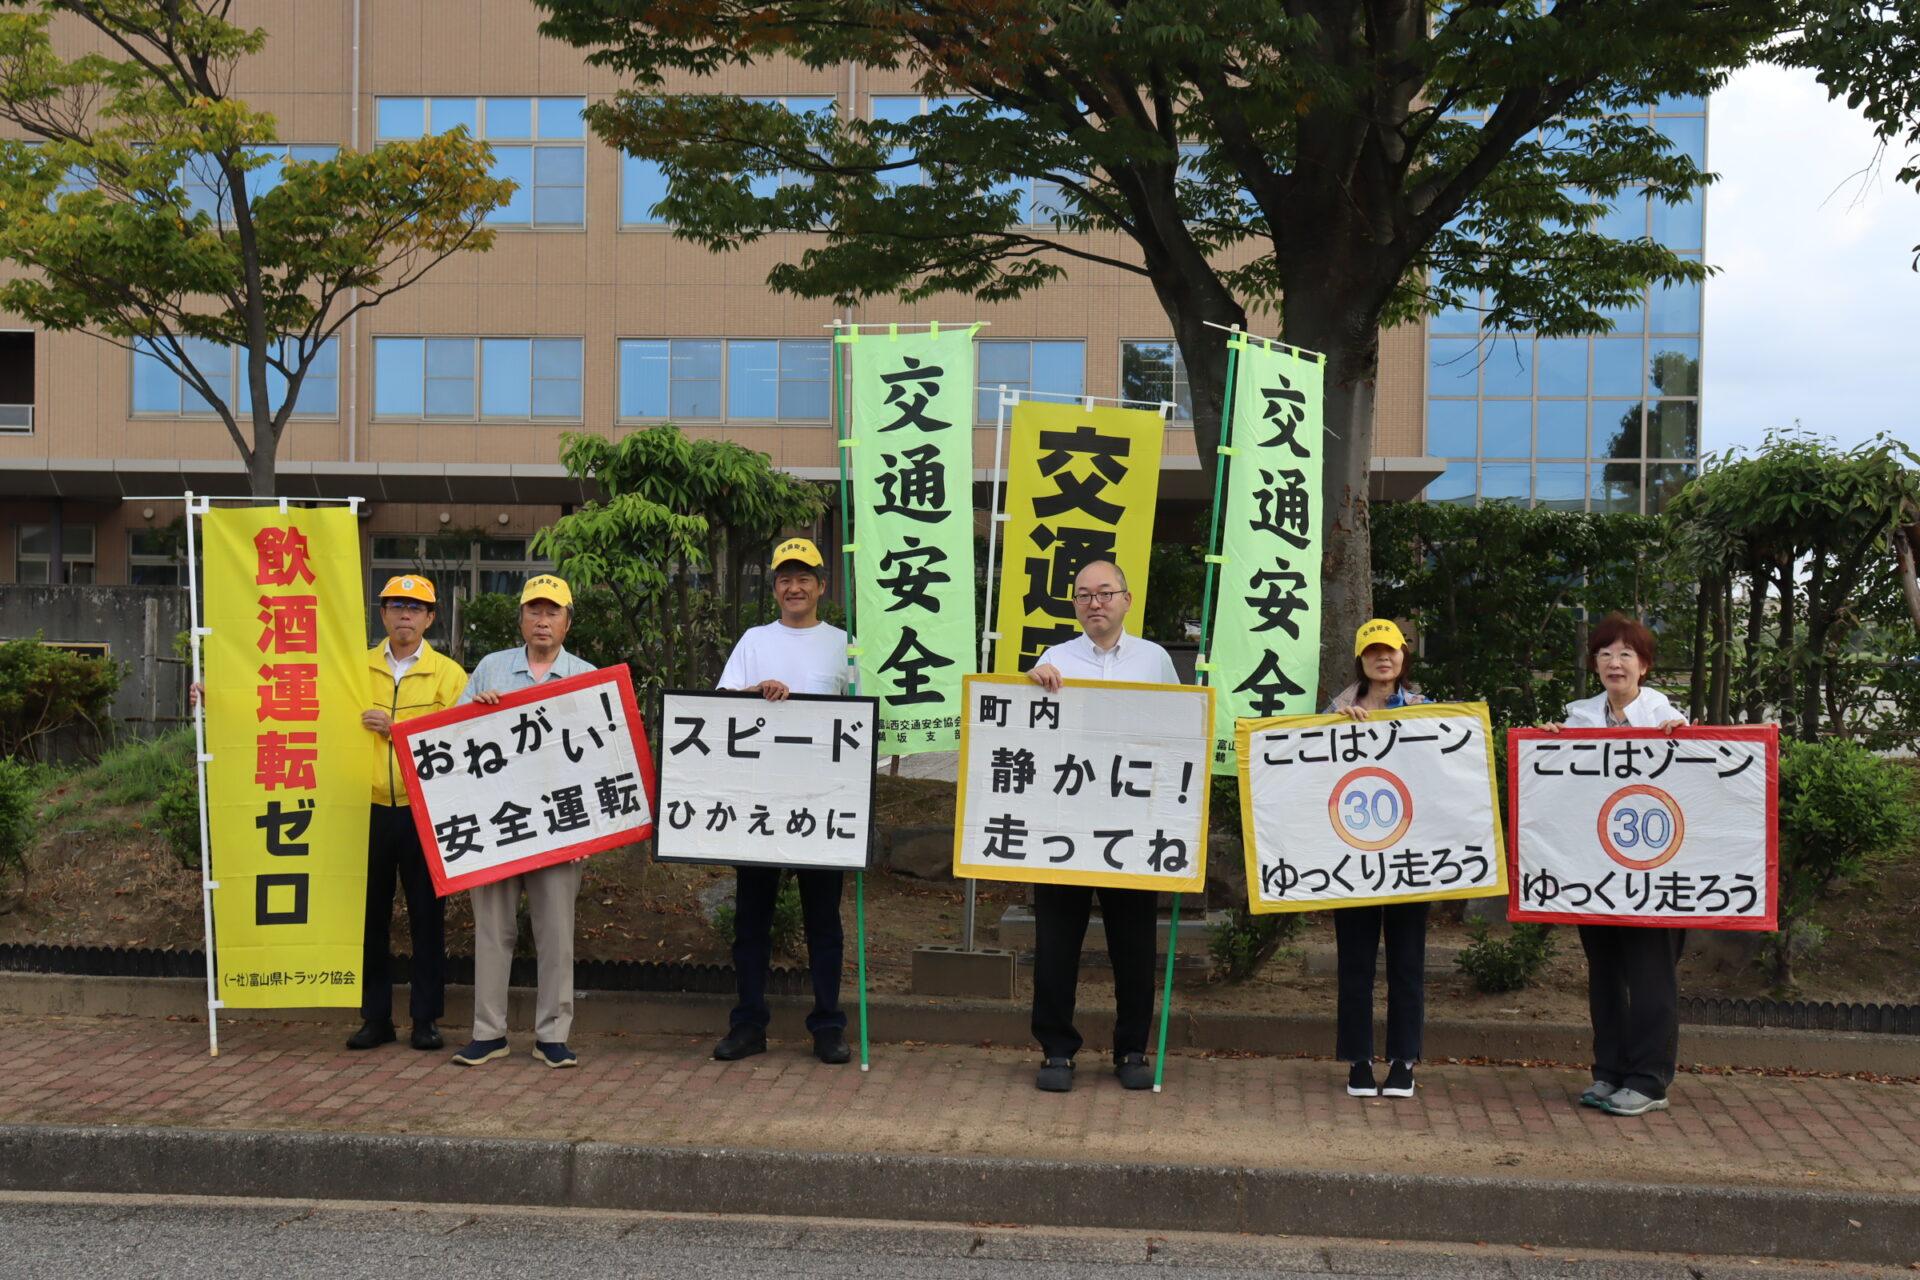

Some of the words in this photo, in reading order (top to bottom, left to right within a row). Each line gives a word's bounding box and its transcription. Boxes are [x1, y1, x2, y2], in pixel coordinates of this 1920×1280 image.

[873, 356, 955, 708] 交通安全
[1231, 373, 1312, 719] 交通安全
[255, 526, 320, 926] 飲酒運転ゼロ
[979, 694, 1060, 730] 町内
[412, 692, 617, 781] おねがい!
[669, 717, 864, 763] スピード
[1263, 722, 1473, 766] ここはゾーン
[1532, 741, 1754, 780] ここはゾーン
[991, 747, 1193, 804] 静かに!
[434, 772, 641, 863] 安全運転
[667, 800, 856, 840] ひかえめに
[1344, 789, 1399, 831] 30
[1613, 808, 1670, 849] 30
[982, 813, 1189, 873] 走ってね
[1261, 846, 1488, 897] ゆっくり走ろう
[1524, 868, 1758, 914] ゆっくり走ろう
